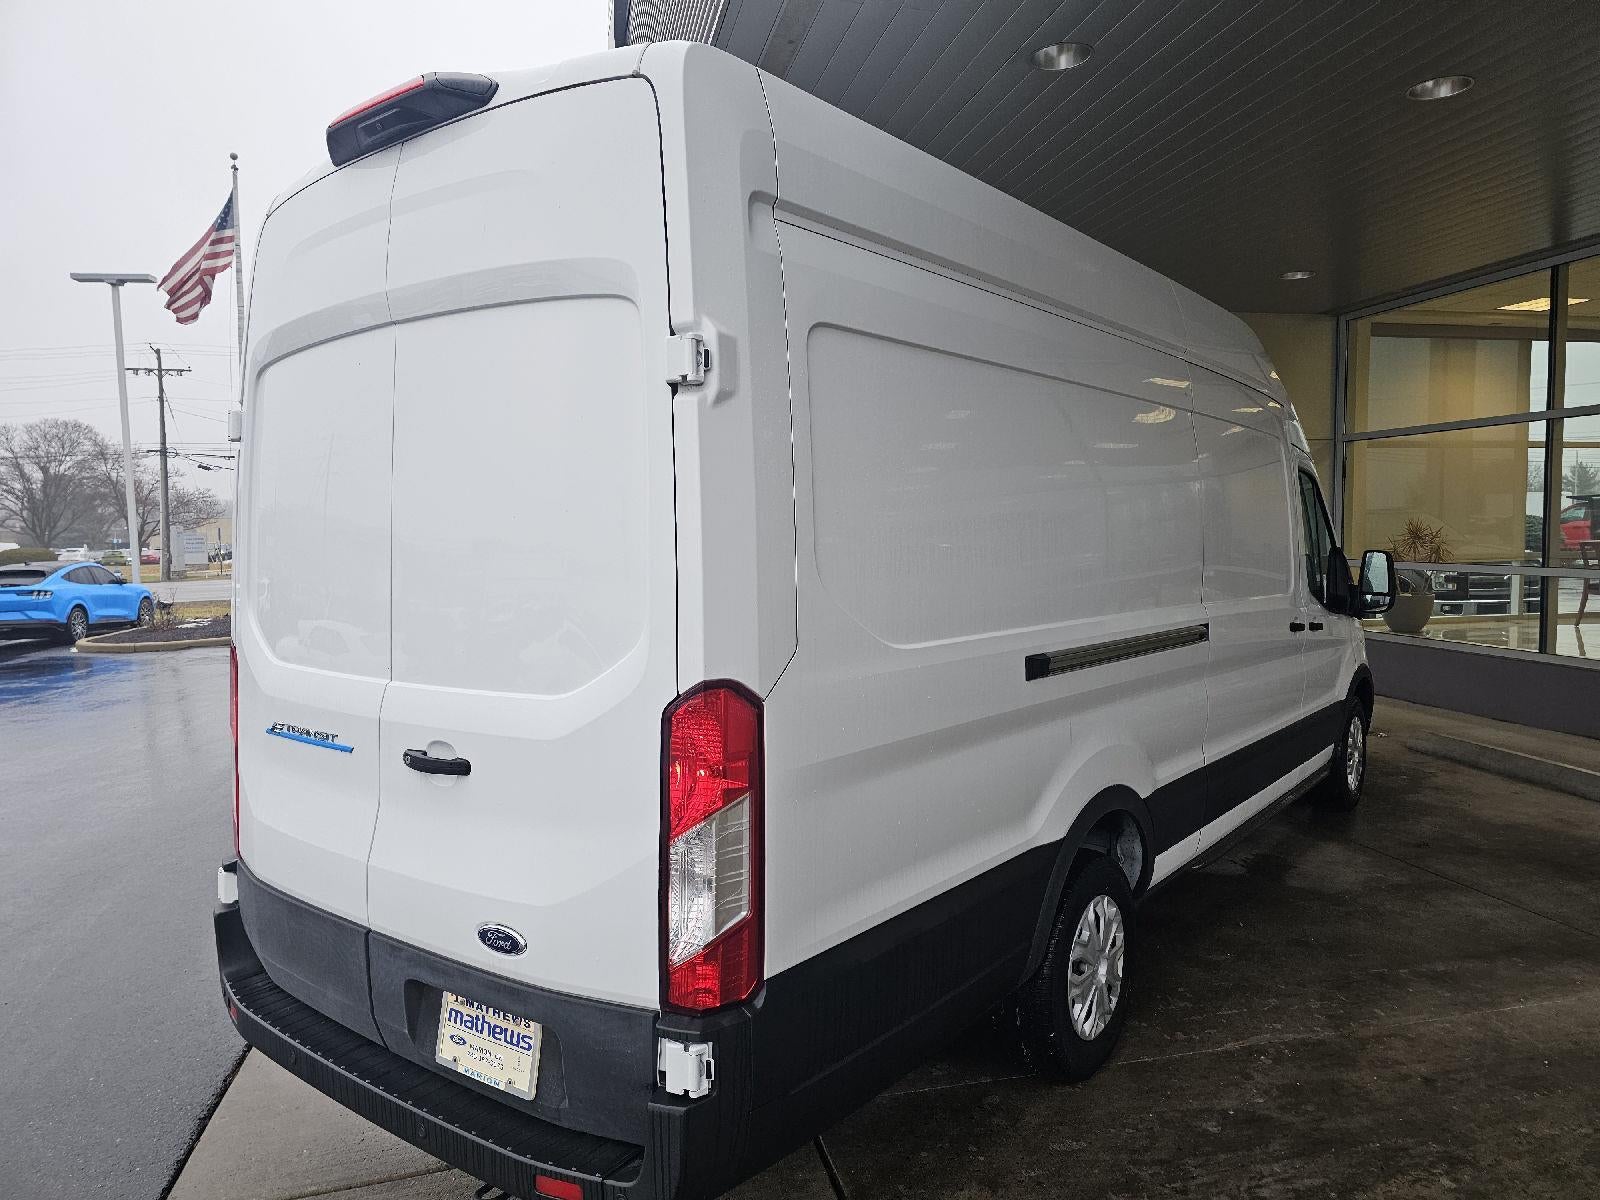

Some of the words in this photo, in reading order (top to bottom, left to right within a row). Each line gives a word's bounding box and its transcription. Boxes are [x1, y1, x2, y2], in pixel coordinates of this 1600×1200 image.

[486, 930, 512, 950] Ford
[448, 1007, 533, 1052] mathews
[463, 1066, 501, 1088] MARION
